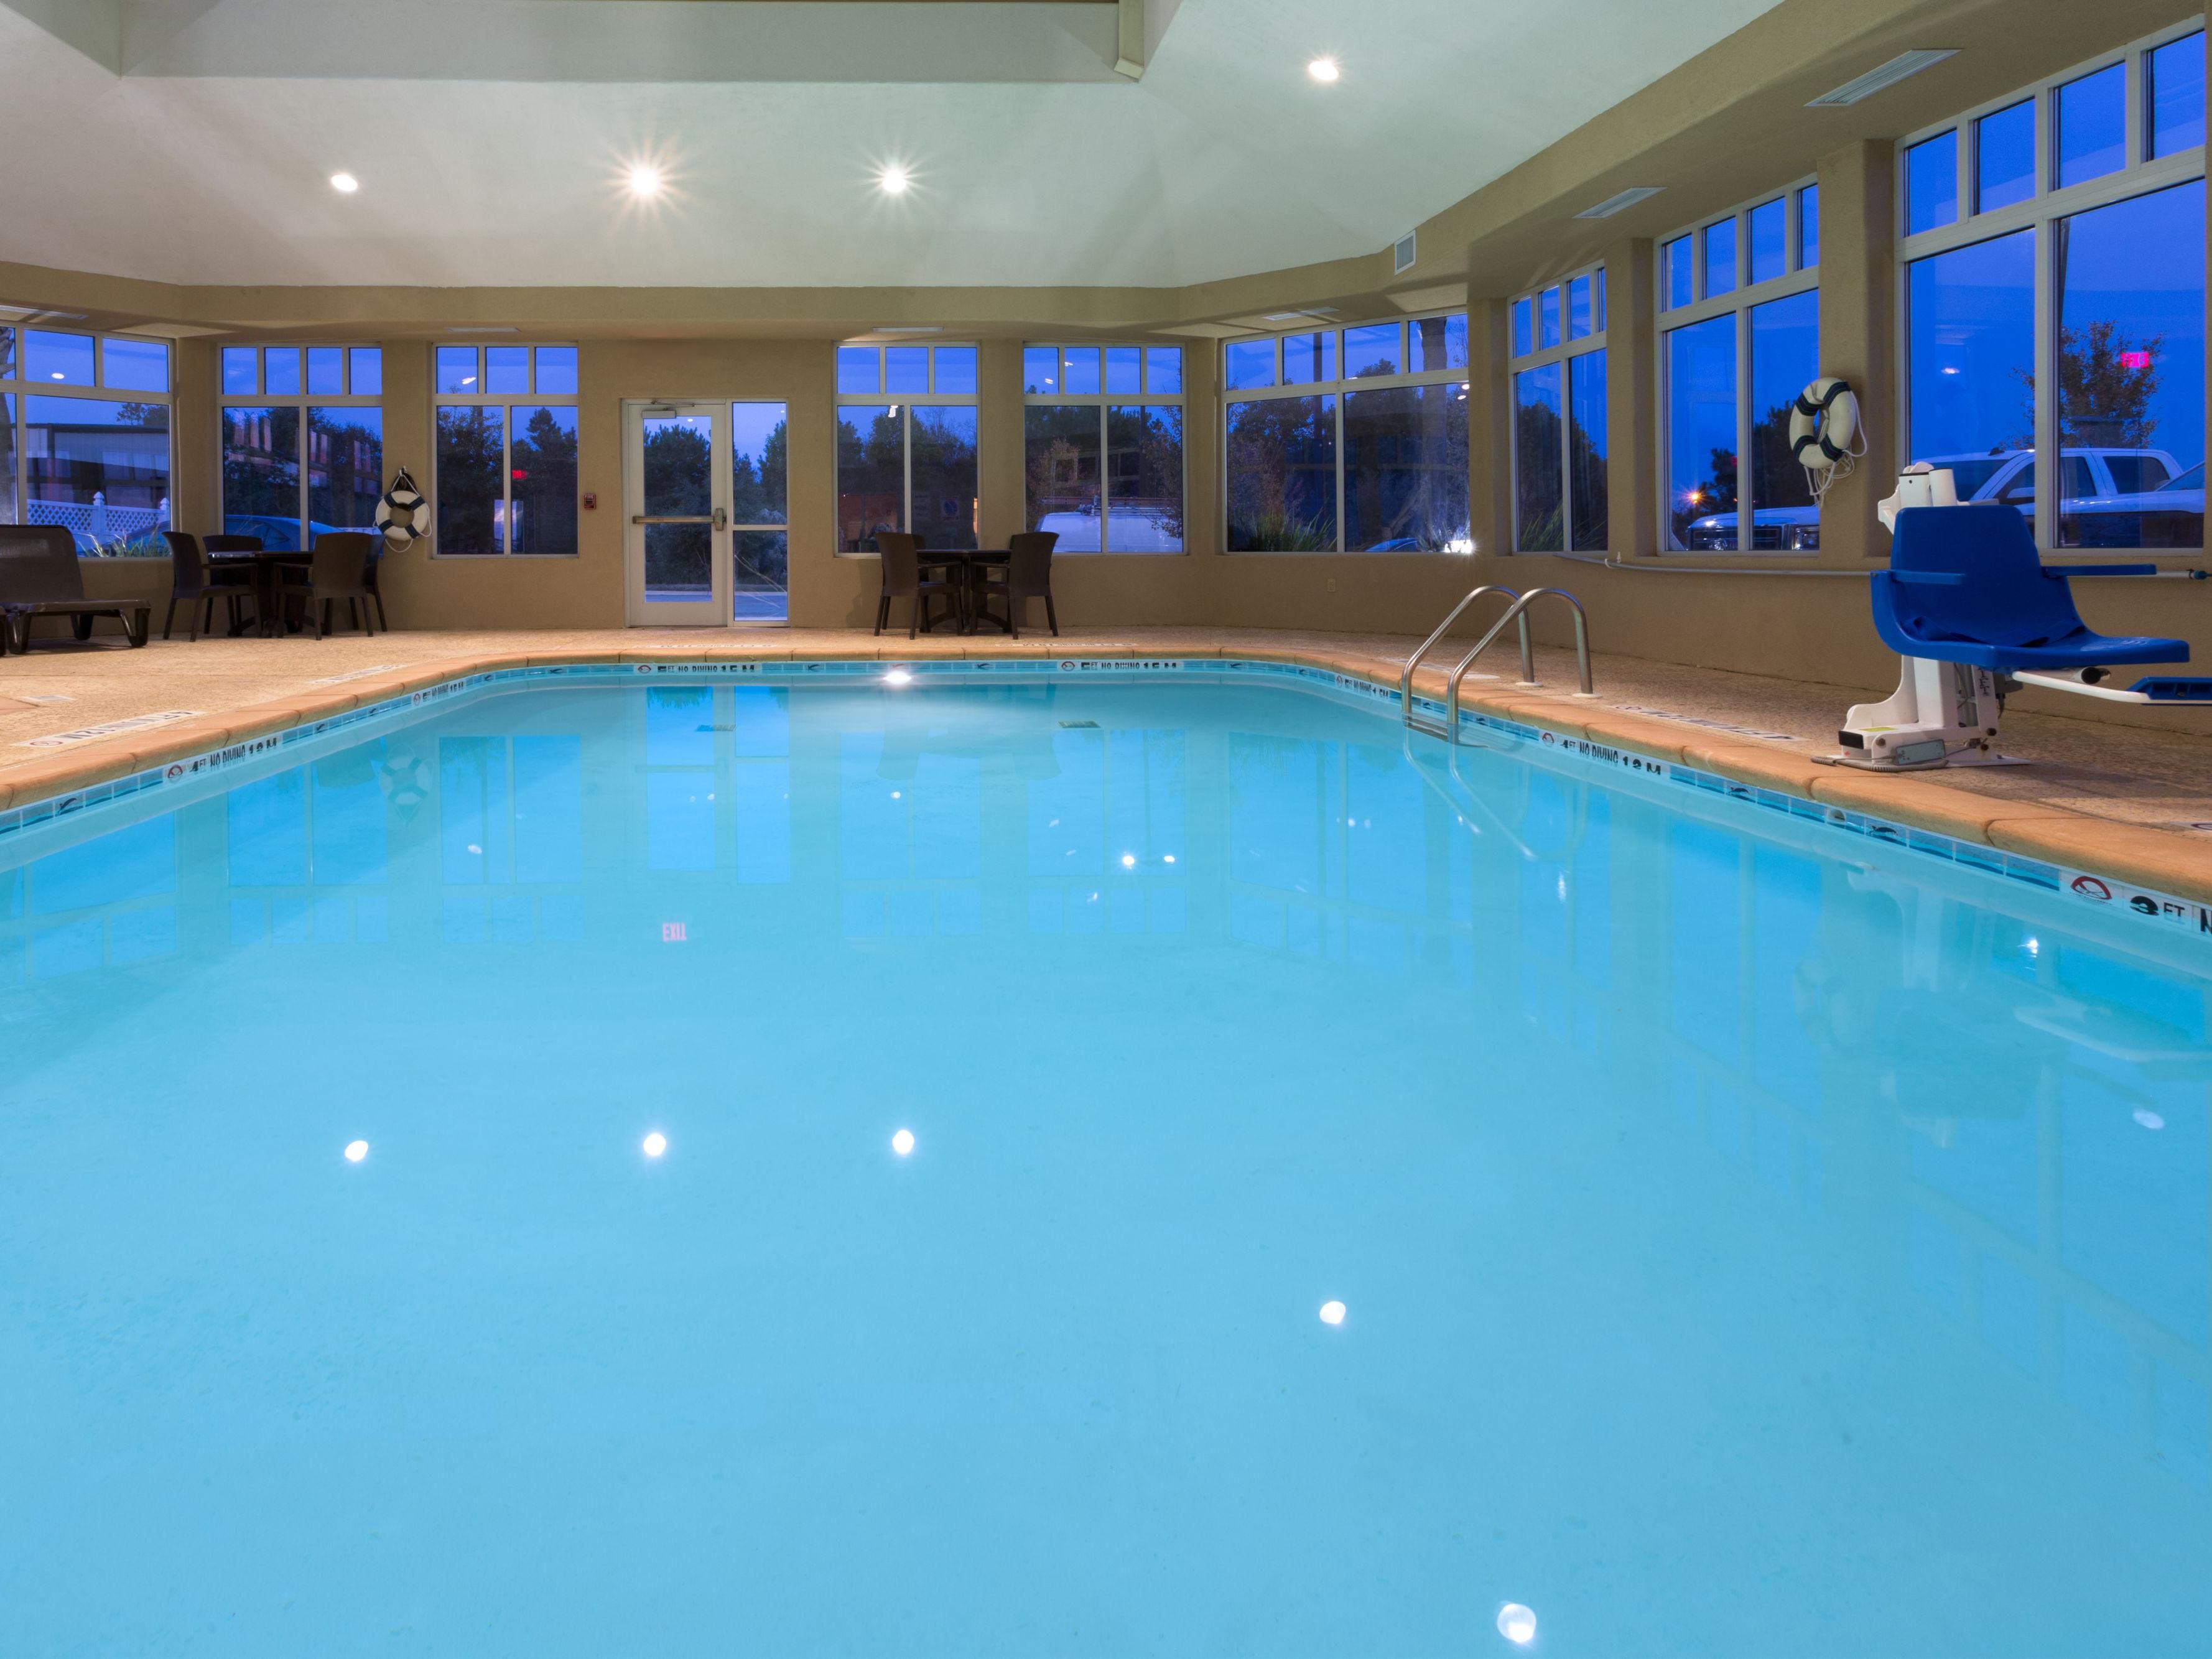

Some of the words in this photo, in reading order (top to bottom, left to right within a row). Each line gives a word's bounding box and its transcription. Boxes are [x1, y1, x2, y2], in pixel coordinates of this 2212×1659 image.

[210, 753, 221, 767] NO
[223, 745, 246, 763] DIVING
[1579, 741, 1589, 755] NO
[1592, 745, 1619, 763] DIVING
